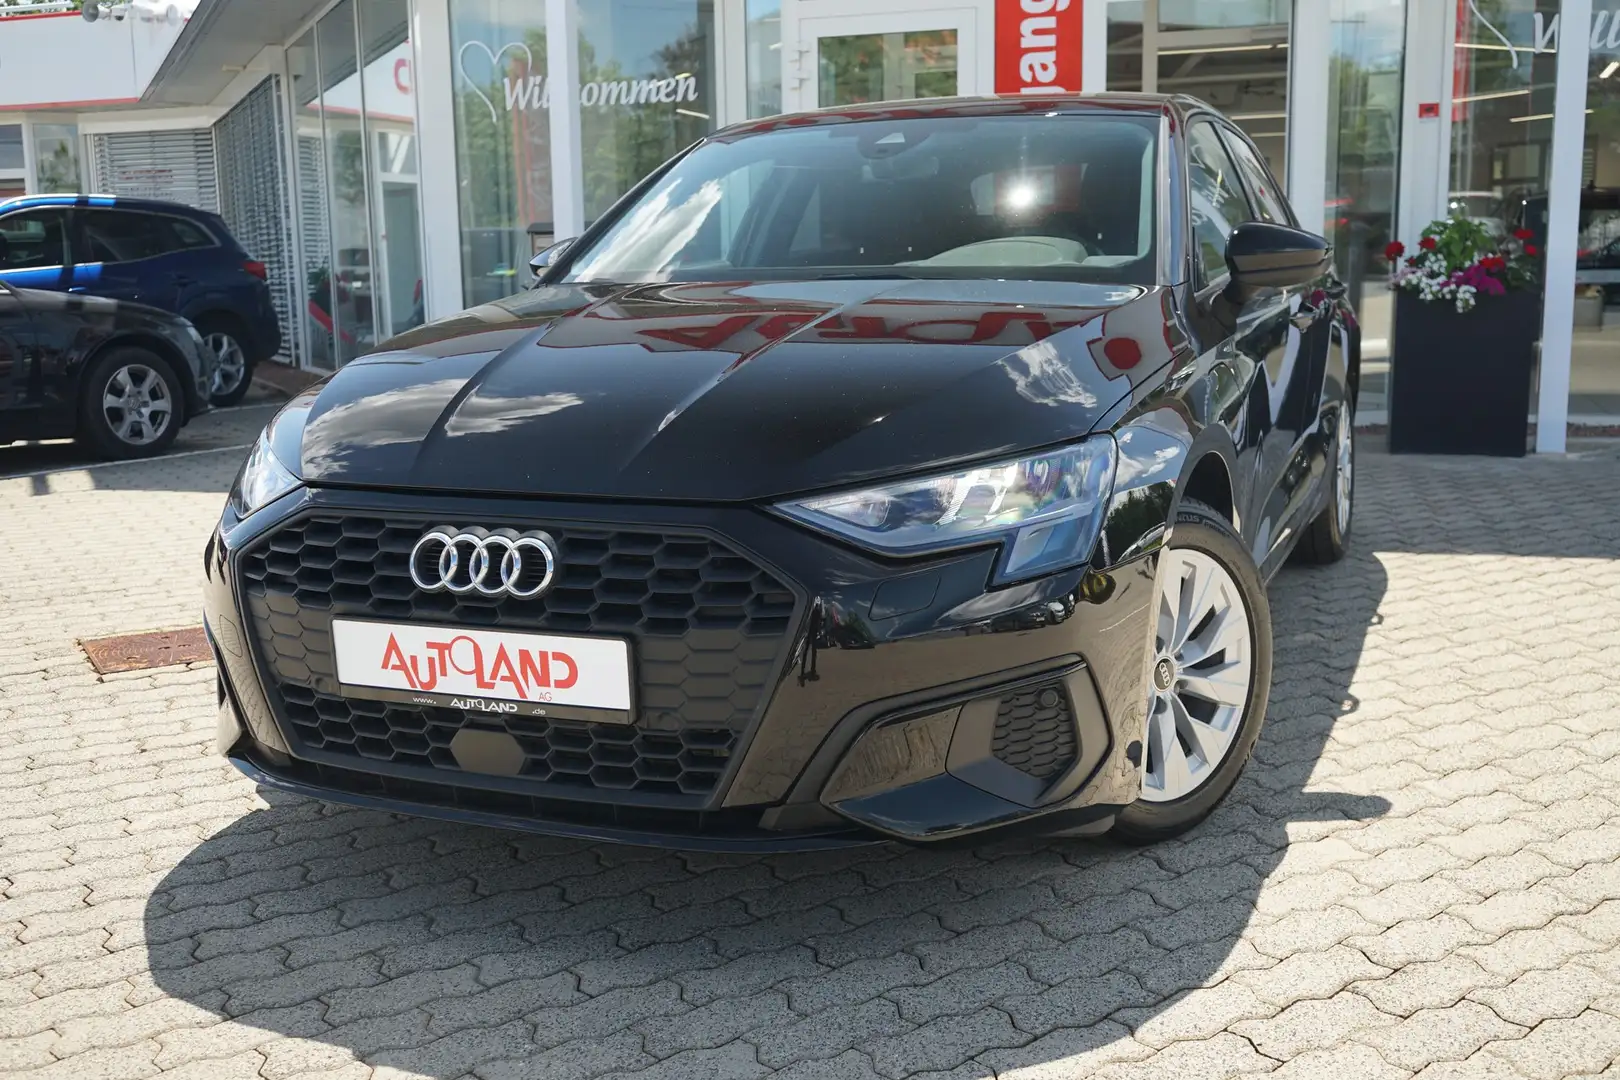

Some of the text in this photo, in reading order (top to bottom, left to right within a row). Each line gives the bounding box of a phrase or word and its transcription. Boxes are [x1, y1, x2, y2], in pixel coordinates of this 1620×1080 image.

[503, 74, 699, 111] Wilommen
[381, 632, 579, 699] AUTOLAND
[412, 697, 546, 716] www. AUTOLAND .de
[538, 692, 553, 702] AG
